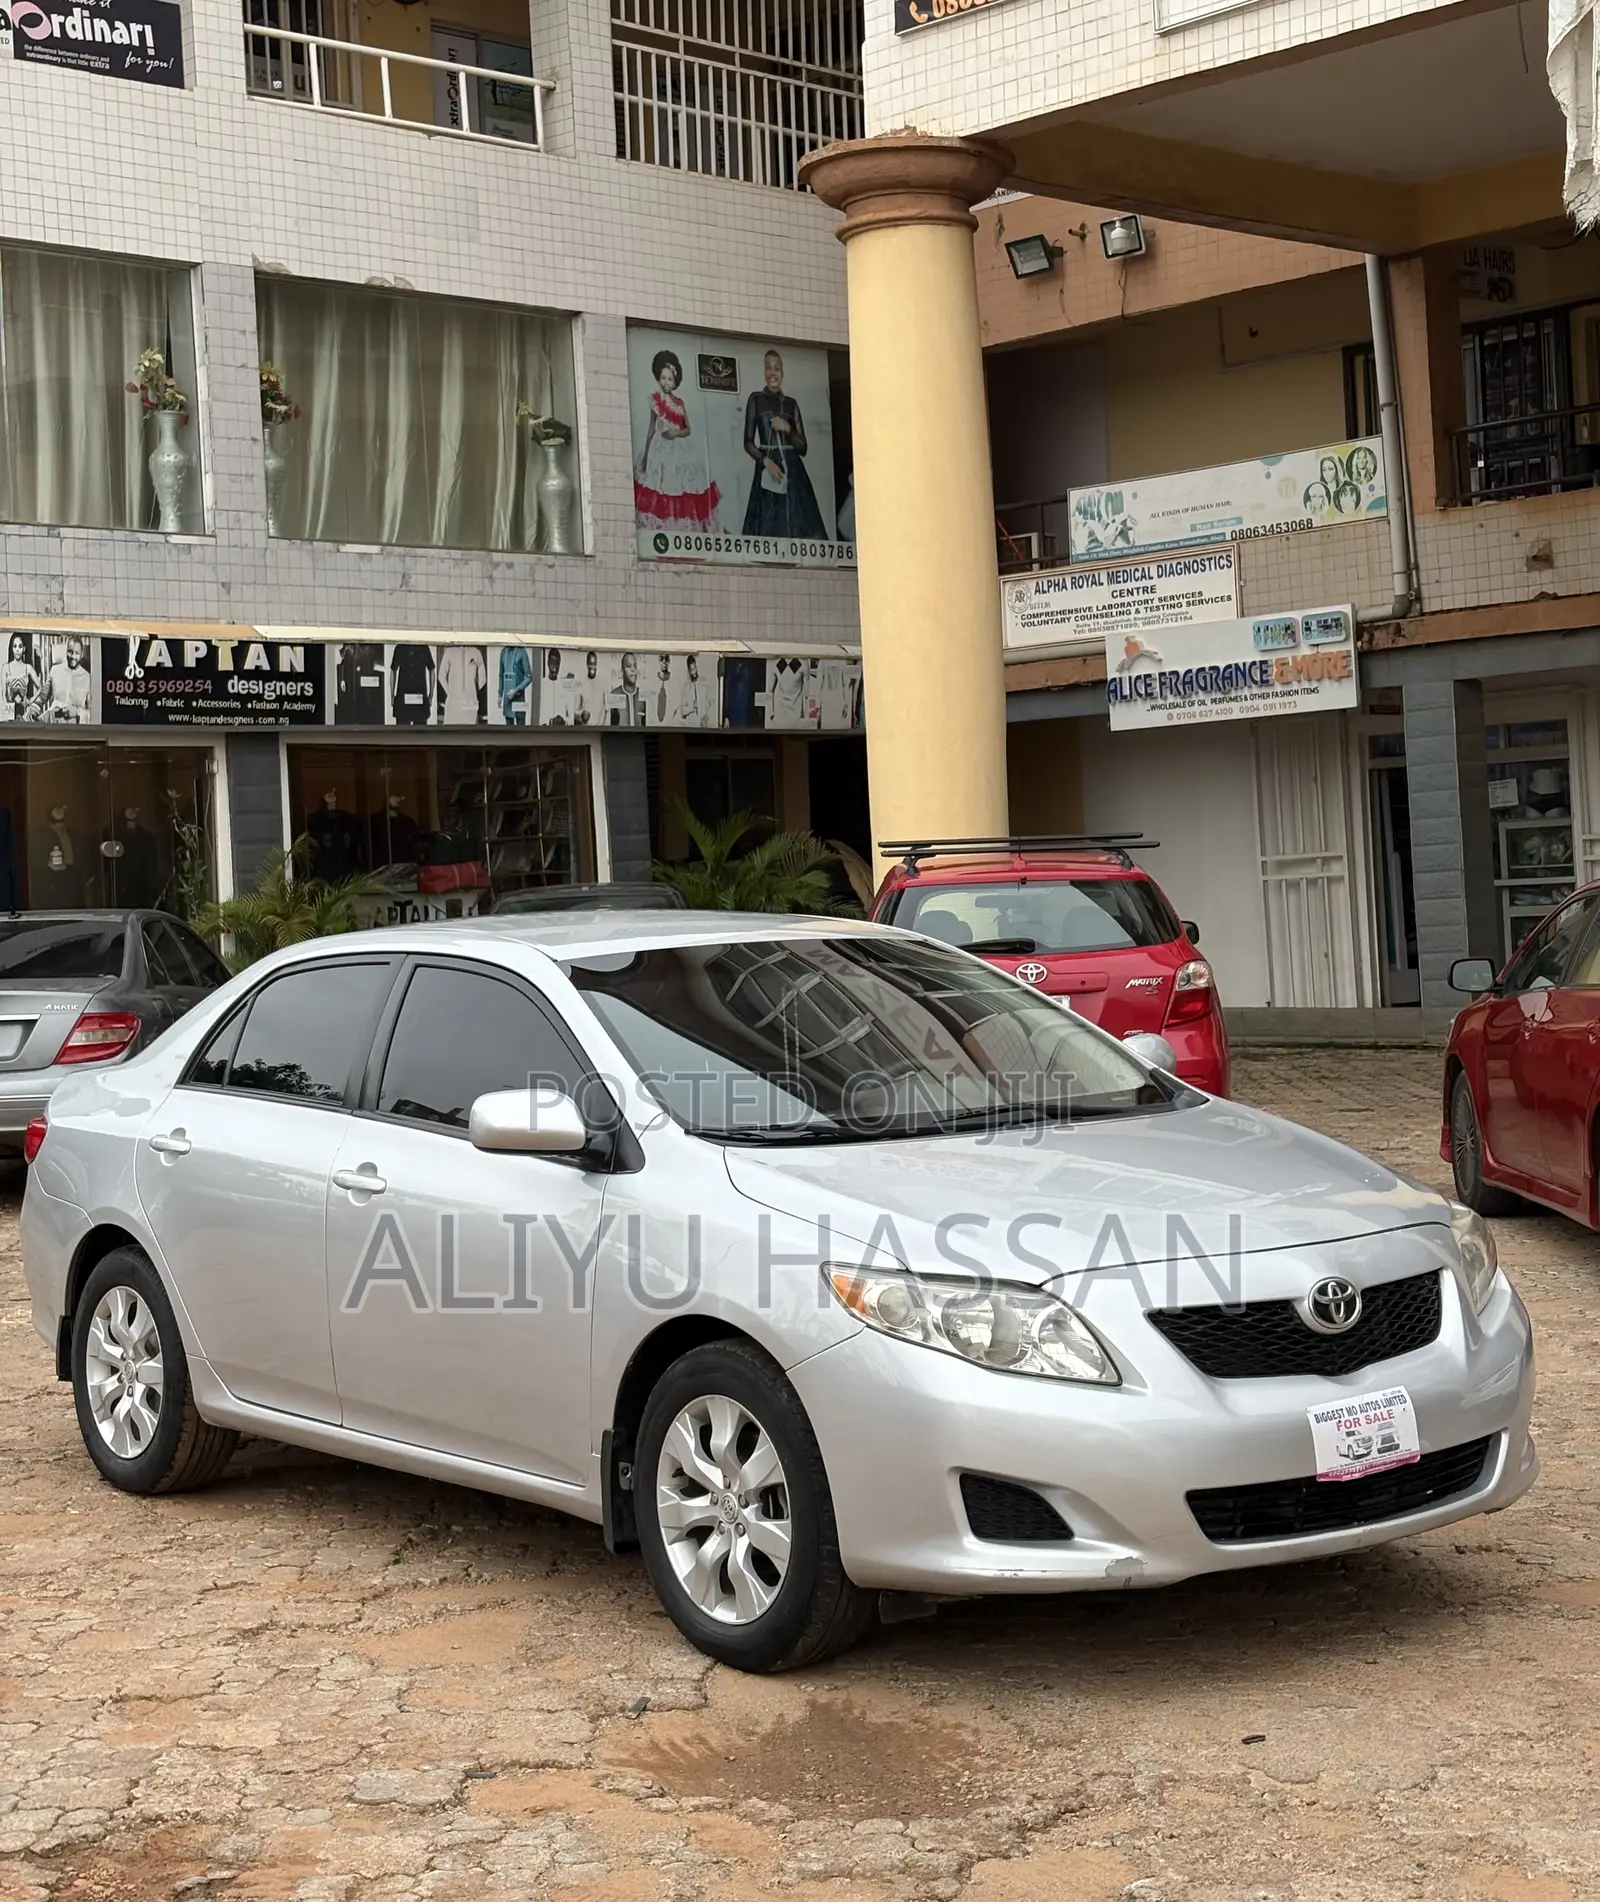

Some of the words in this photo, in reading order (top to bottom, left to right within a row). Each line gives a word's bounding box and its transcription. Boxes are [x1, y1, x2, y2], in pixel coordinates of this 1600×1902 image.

[89, 60, 110, 70] extra
[1230, 517, 1313, 541] 08063453068
[1033, 577, 1068, 596] ALPHA
[1070, 572, 1104, 591] ROYAL
[1106, 566, 1154, 587] MEDICAL
[1156, 553, 1233, 579] DIAGNOSTICS
[1111, 584, 1157, 599] CENTRE
[1020, 605, 1094, 621] COMPREHENSIVE
[1096, 597, 1155, 612] LABORATORY
[1157, 590, 1204, 604] SERVICES
[1020, 615, 1072, 629] VOLUNTARY
[1074, 608, 1132, 622] COUNSELING
[1134, 607, 1141, 615] &
[1143, 601, 1183, 614] TESTING
[1185, 594, 1233, 608] SERVICES
[227, 674, 314, 701] designers
[1106, 673, 1155, 704] ALICE
[1158, 659, 1270, 699] FRAGRANCE
[1274, 656, 1290, 685] &
[1291, 649, 1350, 682] MORE
[114, 695, 149, 709] Tailoring
[161, 697, 185, 708] Fabric
[197, 698, 242, 709] Accessories
[252, 700, 280, 710] Fashion
[282, 701, 316, 714] Academy
[1187, 699, 1196, 708] OF
[1211, 694, 1243, 706] PERFUMES
[1249, 690, 1271, 701] OTHER
[1271, 687, 1300, 699] FASHION
[1300, 686, 1320, 696] ITEMS
[1124, 976, 1164, 989] MATRIX
[1313, 1408, 1346, 1424] BIGGEST
[1345, 1404, 1358, 1417] MO
[1358, 1399, 1382, 1415] AUTOS
[1380, 1393, 1408, 1409] LIMITED
[1336, 1417, 1362, 1432] FOR
[1364, 1408, 1396, 1425] SALE
